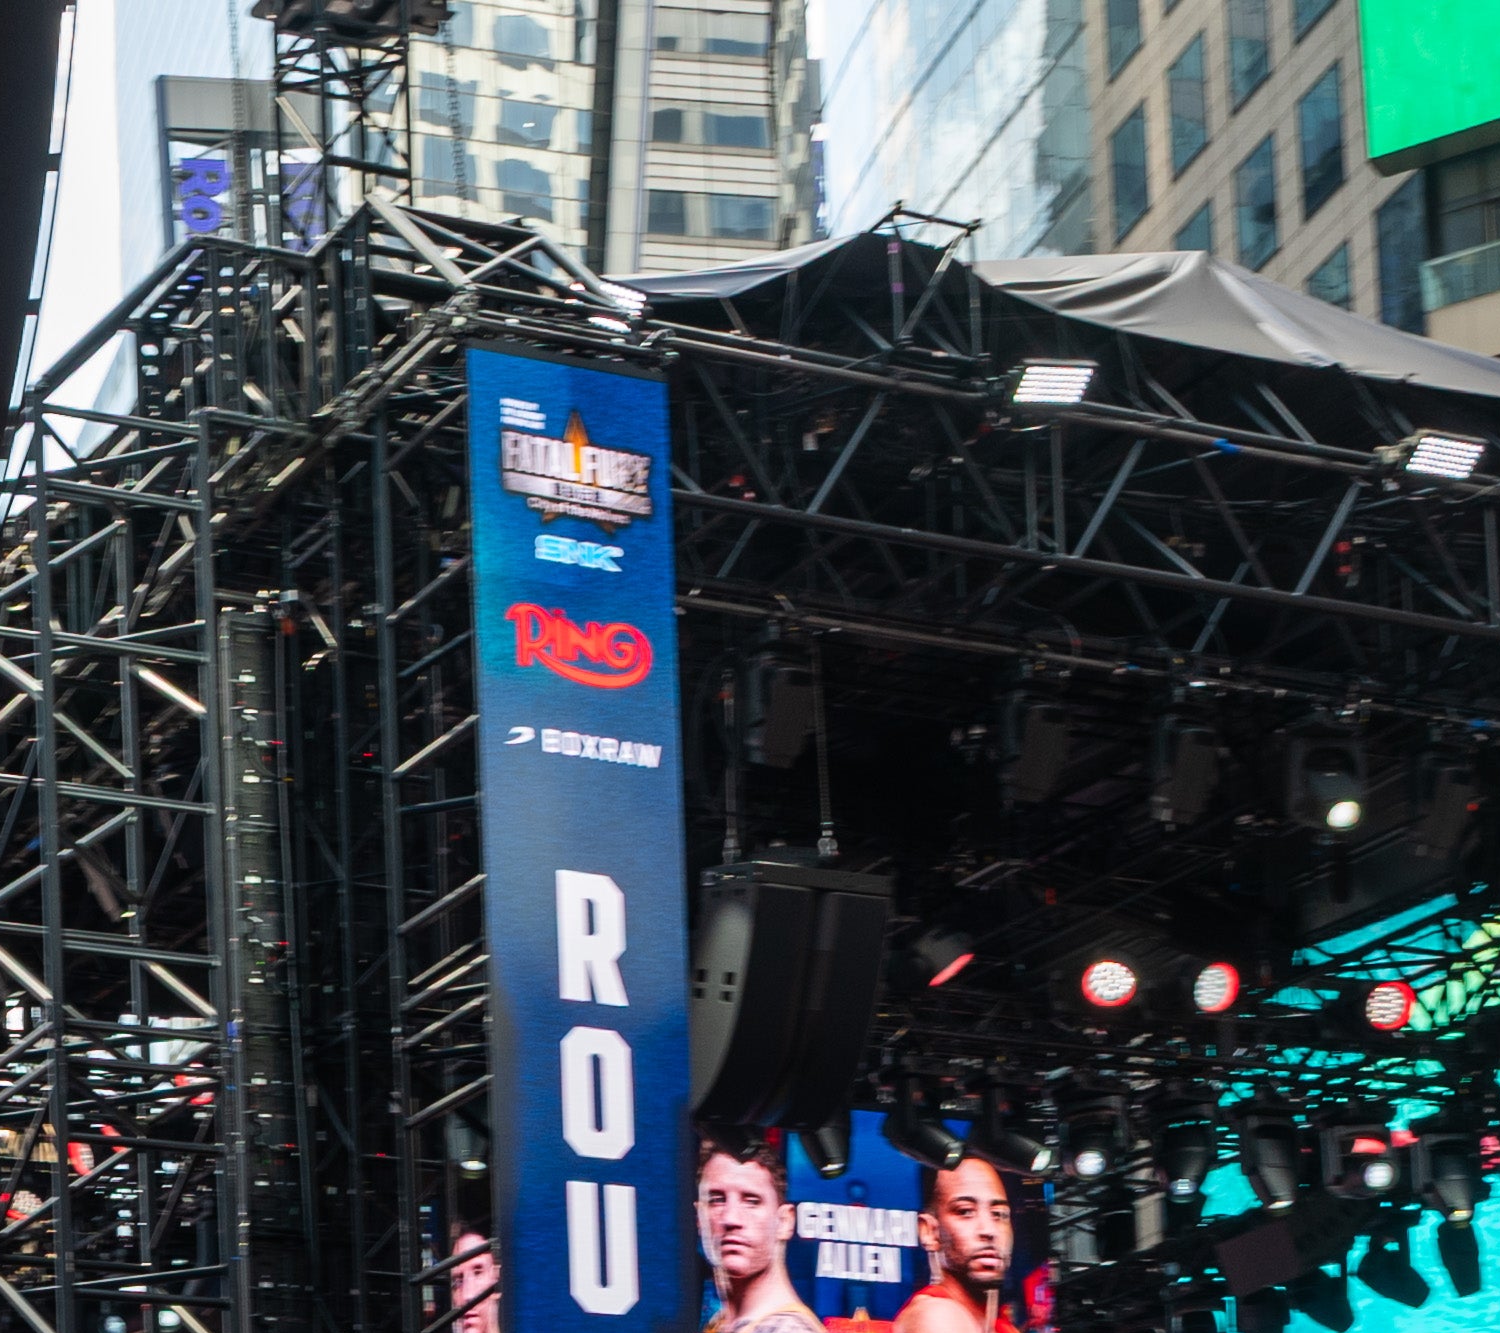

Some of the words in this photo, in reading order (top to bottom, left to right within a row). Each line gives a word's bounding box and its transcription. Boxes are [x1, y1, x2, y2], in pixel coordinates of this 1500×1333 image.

[534, 533, 625, 573] SNK
[505, 602, 653, 689] RING
[541, 727, 663, 769] BOXRAW
